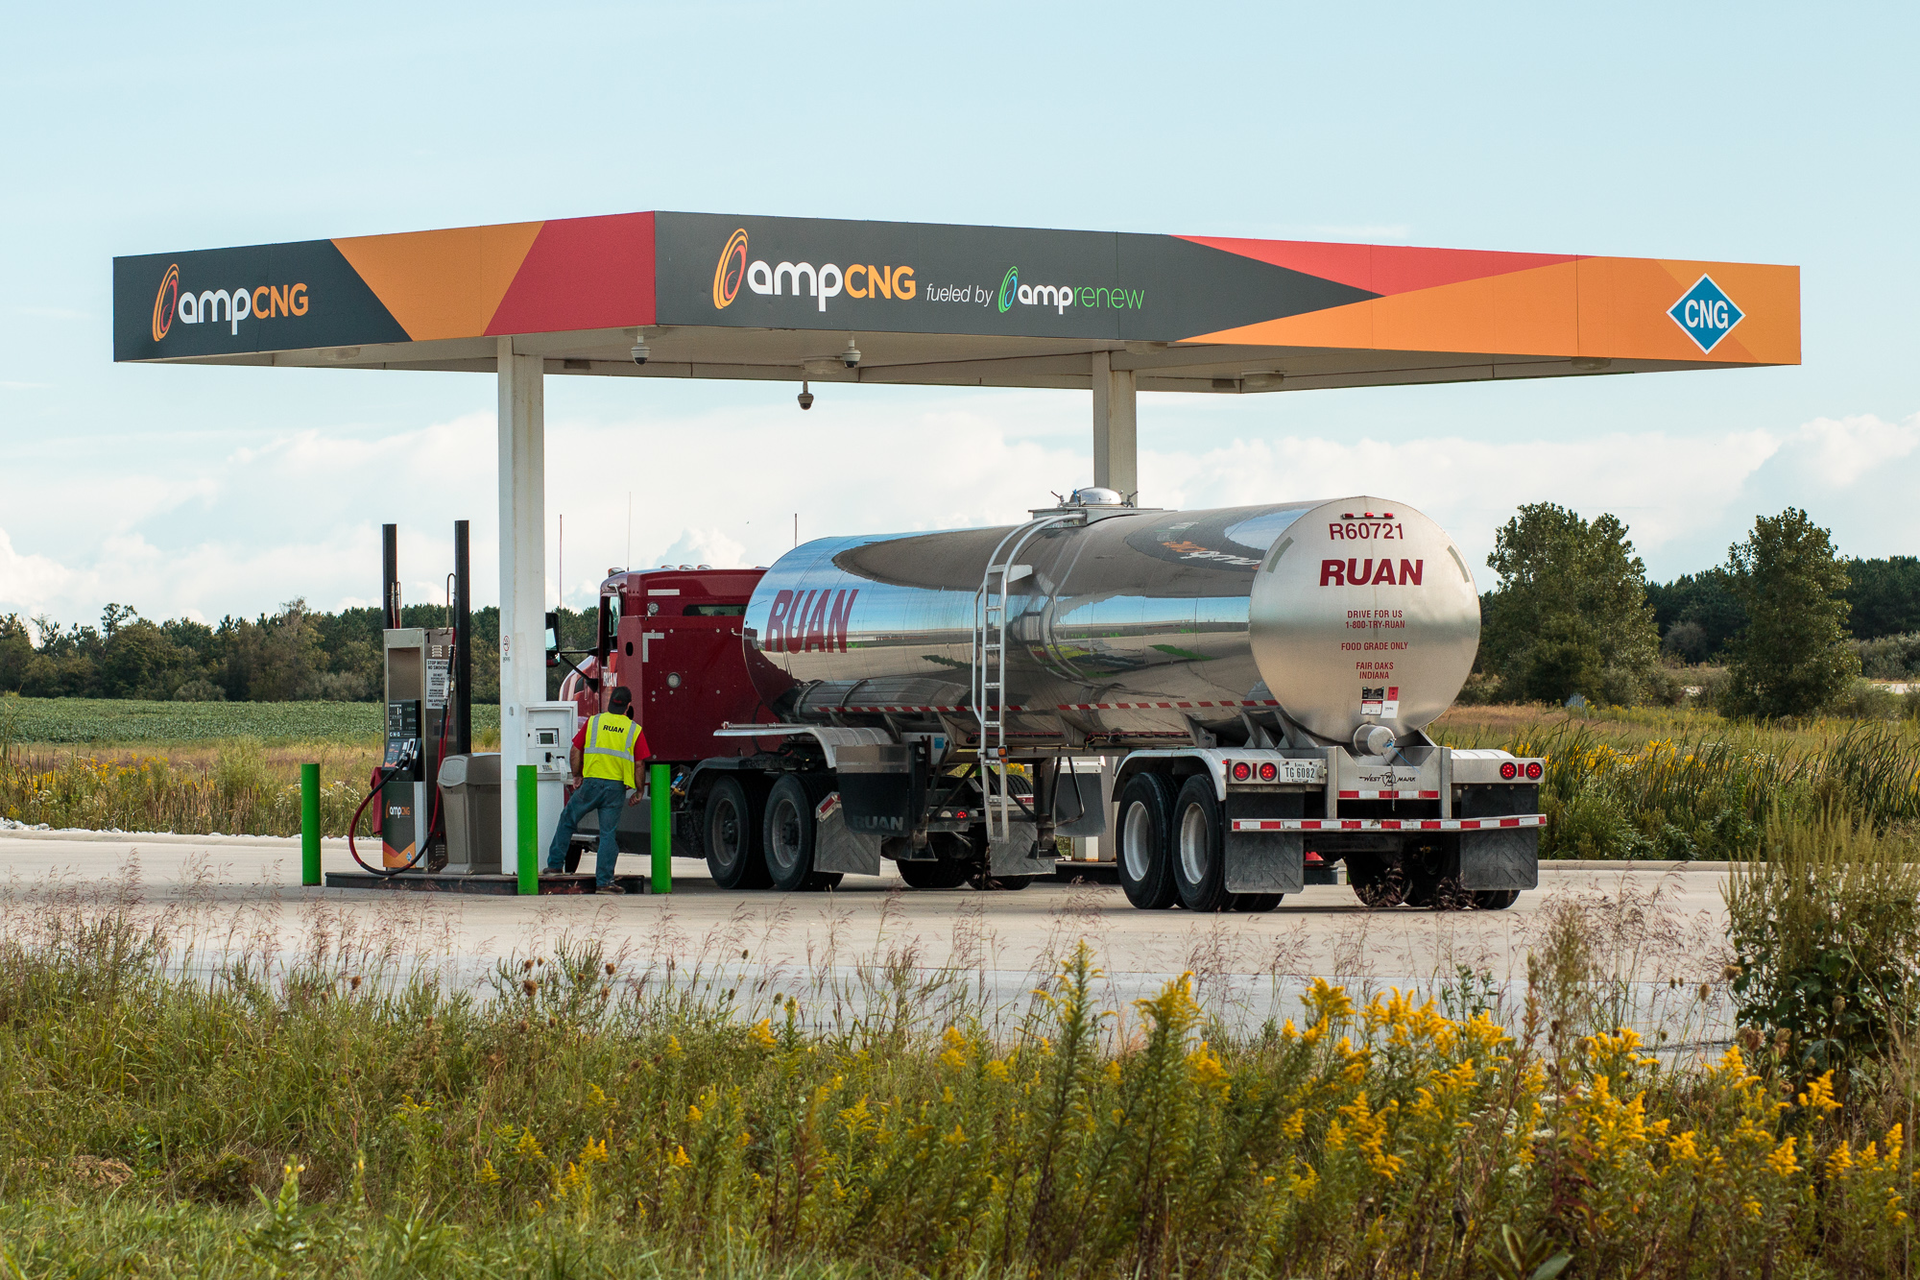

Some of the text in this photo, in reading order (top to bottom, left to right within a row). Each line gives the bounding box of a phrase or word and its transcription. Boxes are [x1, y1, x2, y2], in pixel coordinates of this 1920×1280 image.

[747, 260, 917, 312] ampCNG
[926, 283, 1145, 315] fueled by amprenew
[178, 283, 309, 335] ampCNG
[1684, 299, 1729, 329] CNG
[1329, 522, 1403, 540] R60721
[1319, 558, 1424, 586] RUAN
[1347, 610, 1403, 618] DRIVE FOR US
[765, 589, 859, 654] RUAN
[1345, 620, 1406, 629] 1-800-TRY-RUAN
[425, 631, 430, 643] 1
[1341, 641, 1409, 650] FOOD GRADE ONLY
[1356, 661, 1394, 670] FAIR OAKS
[1359, 671, 1390, 679] INDIANA
[602, 724, 625, 733] RUAN
[1285, 767, 1315, 778] TG 6082
[1359, 773, 1381, 781] WEST
[852, 816, 904, 831] RUAN
